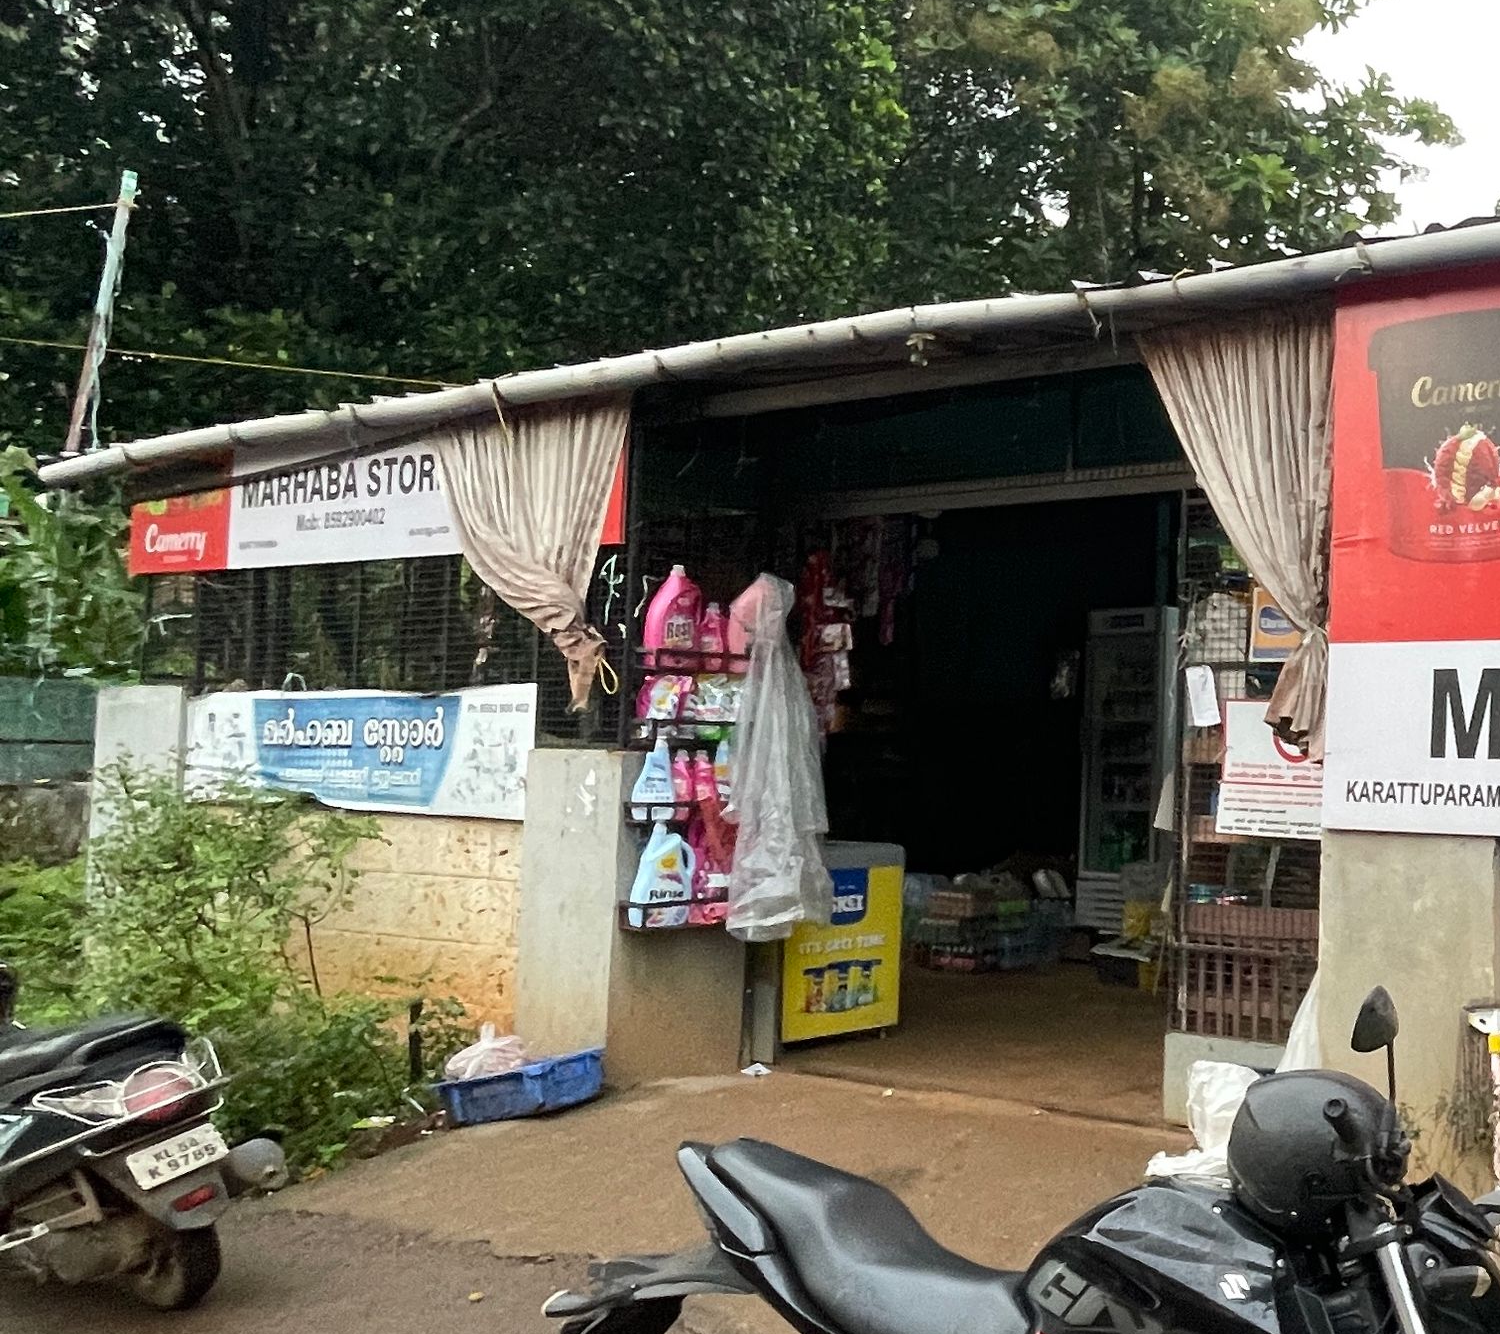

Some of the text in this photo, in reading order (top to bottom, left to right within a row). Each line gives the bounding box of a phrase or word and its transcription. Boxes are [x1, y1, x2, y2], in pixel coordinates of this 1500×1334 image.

[241, 453, 441, 509] MARHABA STOR
[1429, 524, 1455, 536] RED
[147, 1166, 164, 1180] K
